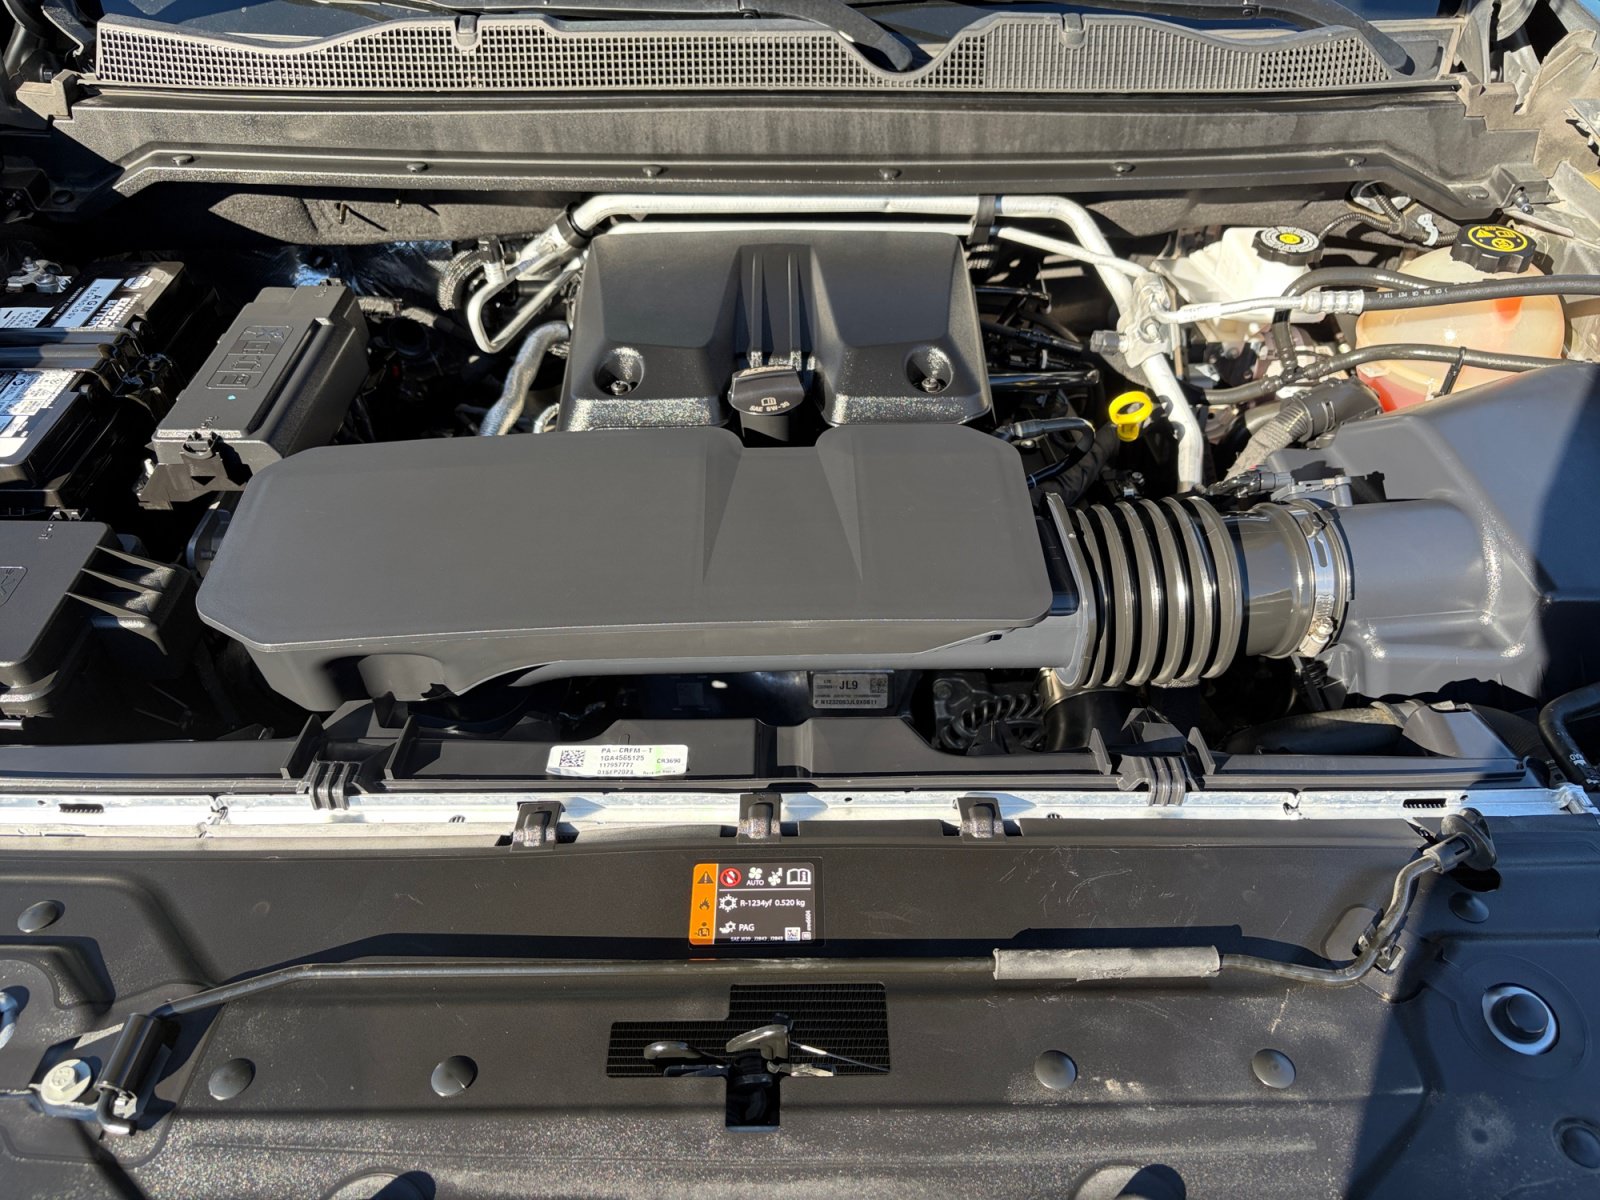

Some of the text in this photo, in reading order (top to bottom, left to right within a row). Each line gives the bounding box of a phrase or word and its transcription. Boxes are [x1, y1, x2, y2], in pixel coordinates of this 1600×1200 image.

[81, 294, 102, 313] AGM
[839, 680, 858, 690] JL9
[740, 898, 773, 908] R-1234yf
[796, 898, 806, 908] kg
[738, 923, 755, 932] PAG
